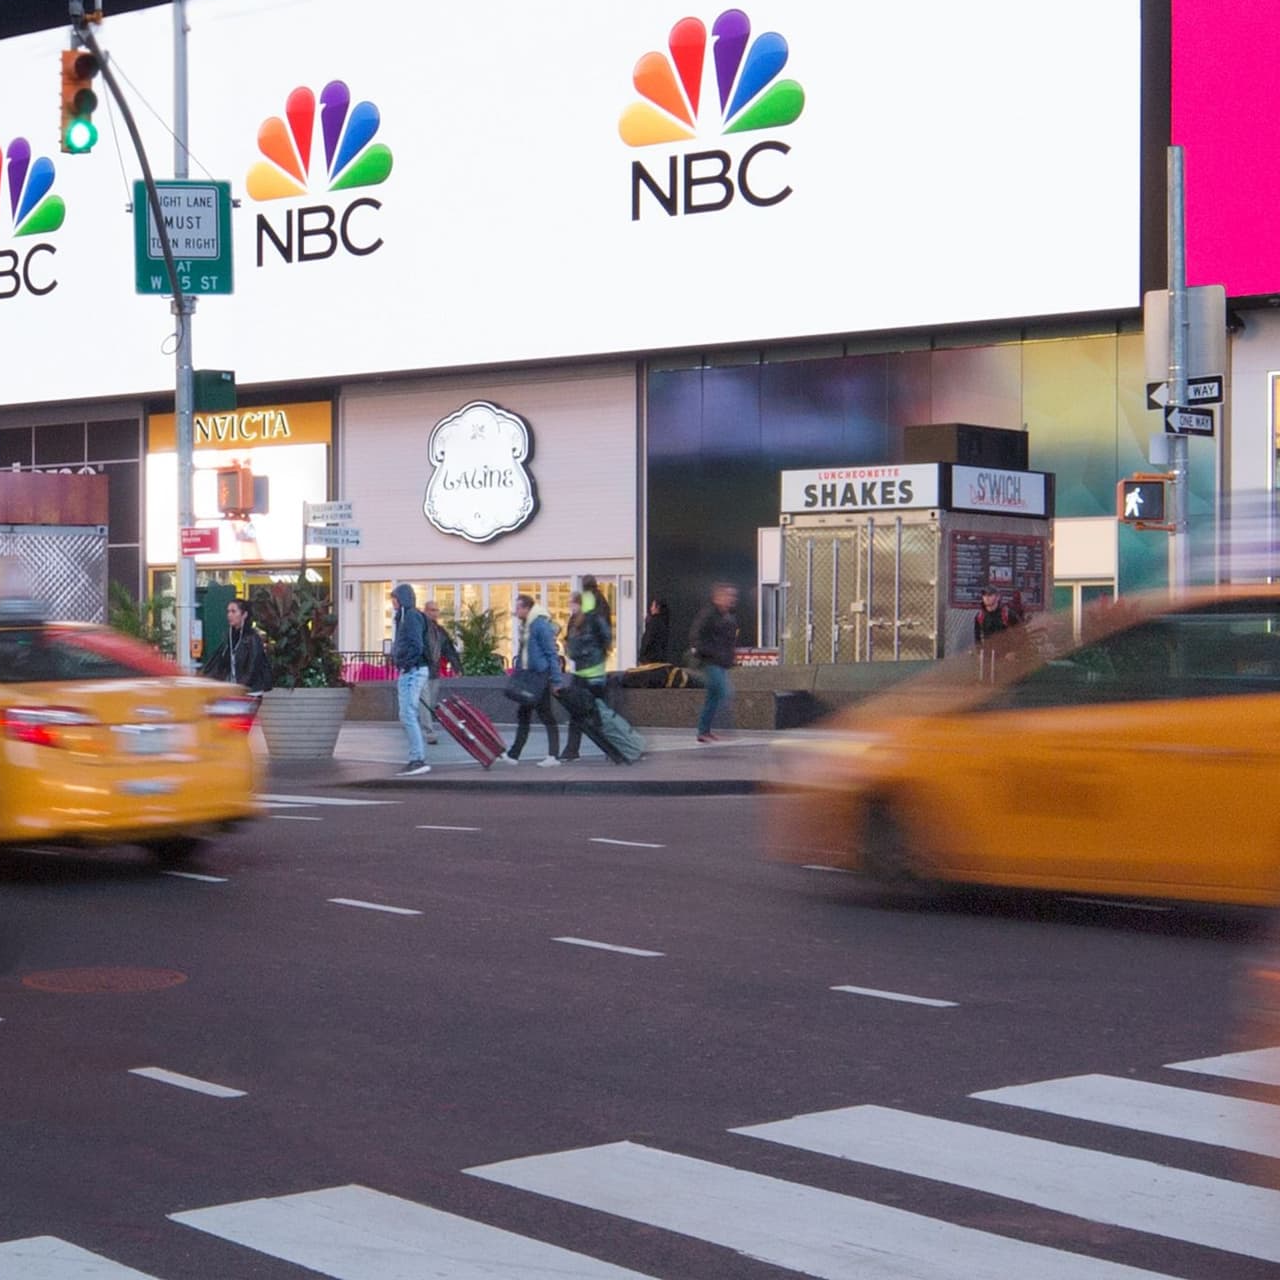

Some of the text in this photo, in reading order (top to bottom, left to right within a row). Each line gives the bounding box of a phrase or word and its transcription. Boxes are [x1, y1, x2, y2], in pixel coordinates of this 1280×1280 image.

[632, 140, 794, 222] NBC
[159, 195, 213, 208] IGHT LANE
[164, 215, 202, 230] MUST
[256, 197, 384, 267] NBC
[185, 237, 216, 249] RIGHT
[176, 261, 192, 273] AT
[150, 276, 162, 290] W
[201, 276, 218, 290] ST
[1193, 384, 1215, 397] WAY
[1180, 415, 1209, 429] ONE WAY
[818, 468, 900, 480] LUNCHEONETTE
[804, 480, 913, 508] SHAKES
